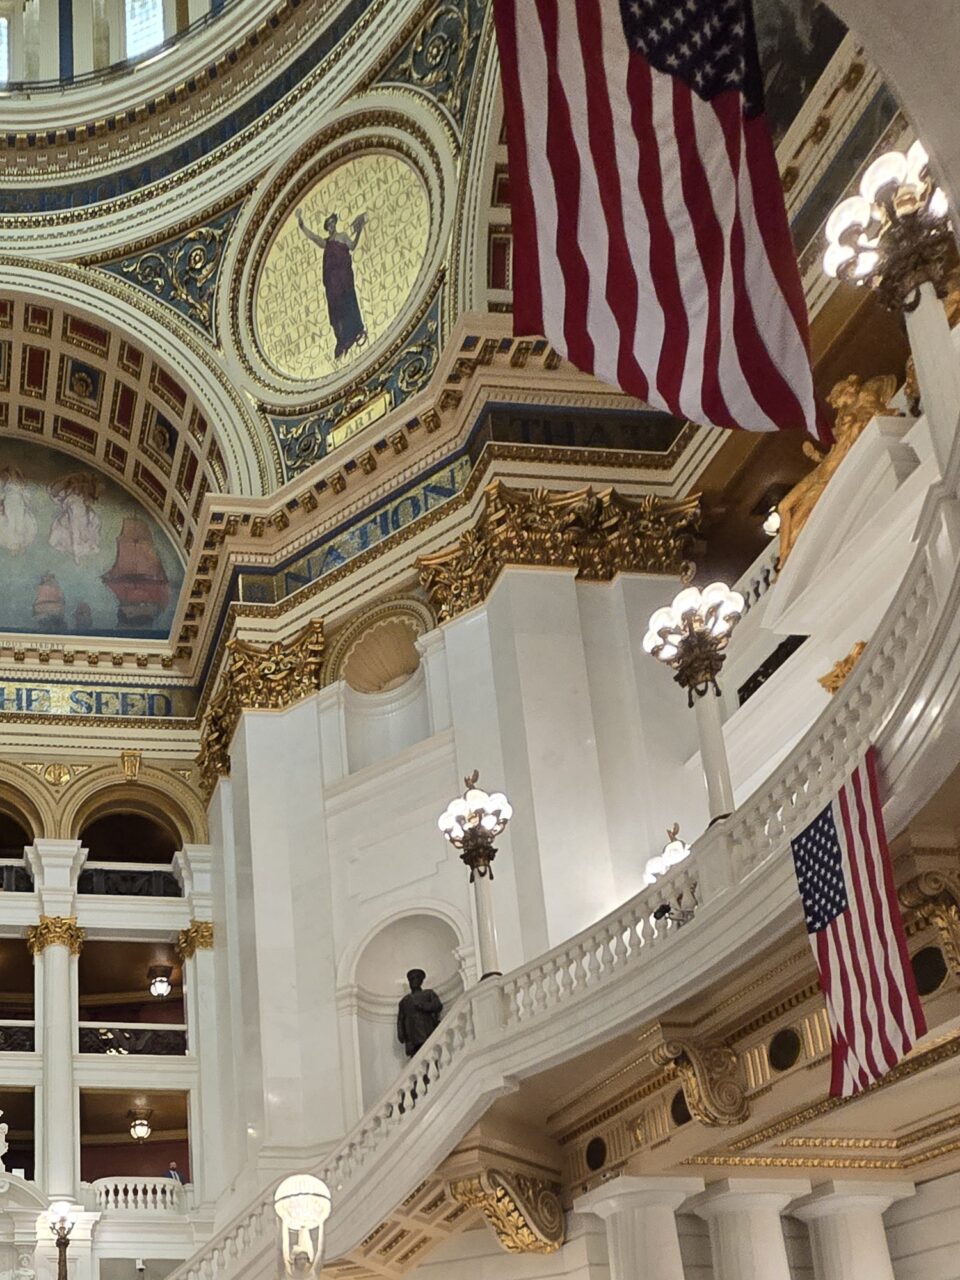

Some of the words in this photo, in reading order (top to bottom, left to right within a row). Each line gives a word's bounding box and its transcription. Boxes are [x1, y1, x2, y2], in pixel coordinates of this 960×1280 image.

[343, 407, 375, 439] ART
[510, 416, 653, 450] THAT
[68, 690, 174, 717] SEED
